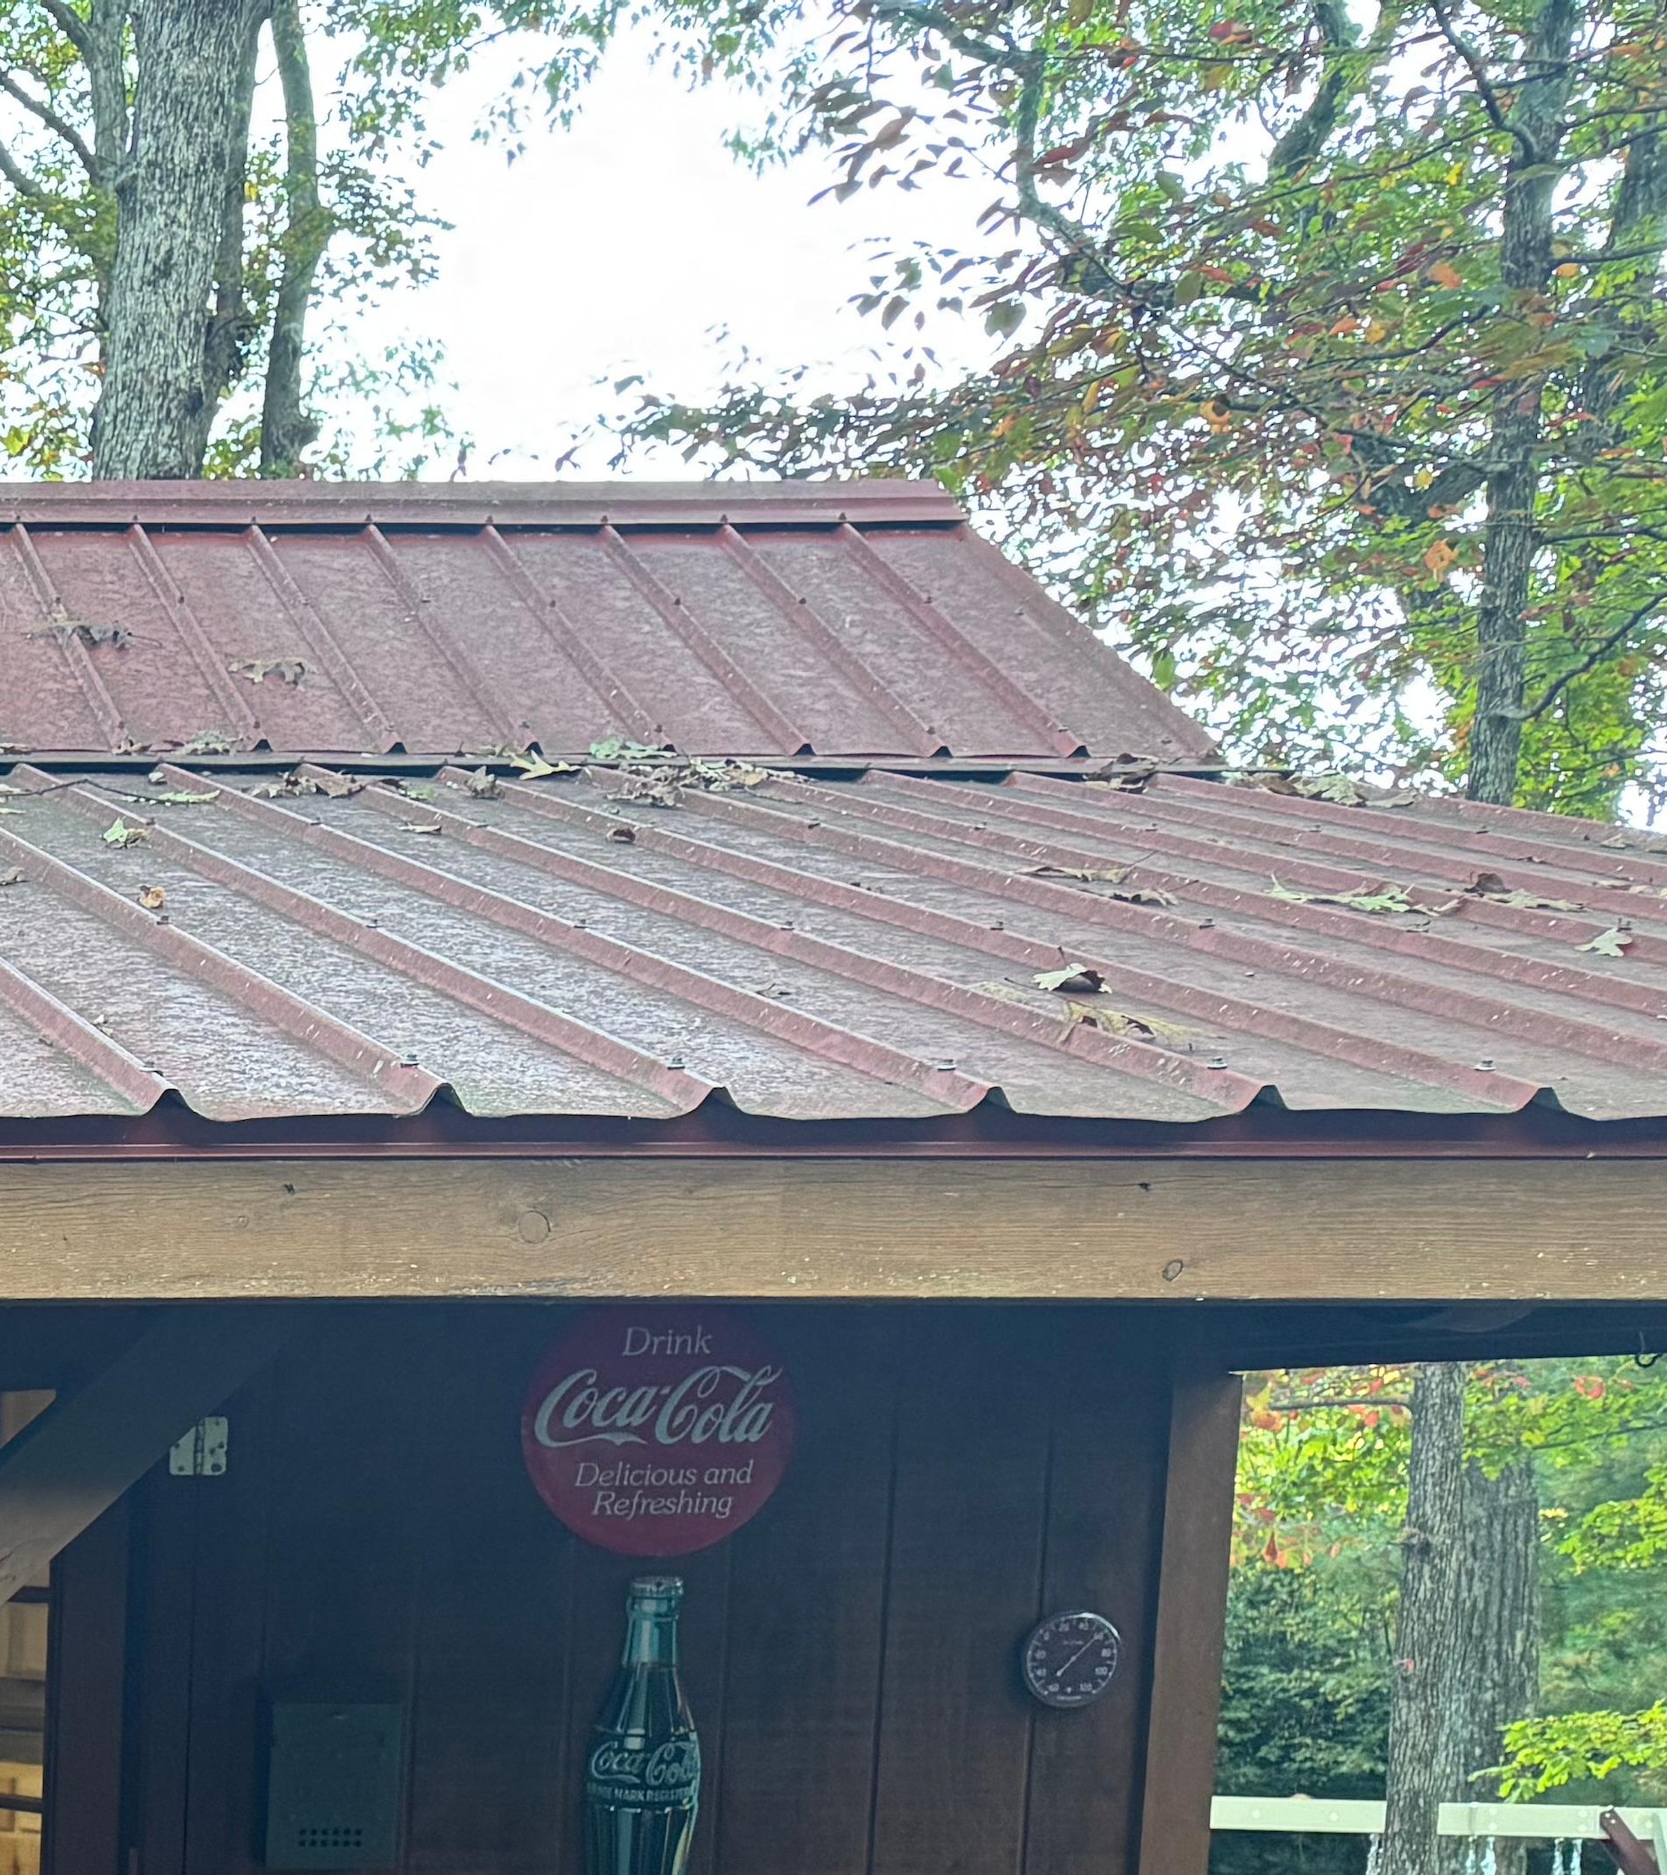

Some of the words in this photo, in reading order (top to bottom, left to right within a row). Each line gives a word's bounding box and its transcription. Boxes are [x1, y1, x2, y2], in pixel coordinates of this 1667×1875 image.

[622, 1326, 713, 1357] Drink
[534, 1365, 784, 1447] Coca-Cola
[574, 1462, 697, 1488] Delicious
[703, 1459, 754, 1485] and
[591, 1491, 734, 1521] Refreshing
